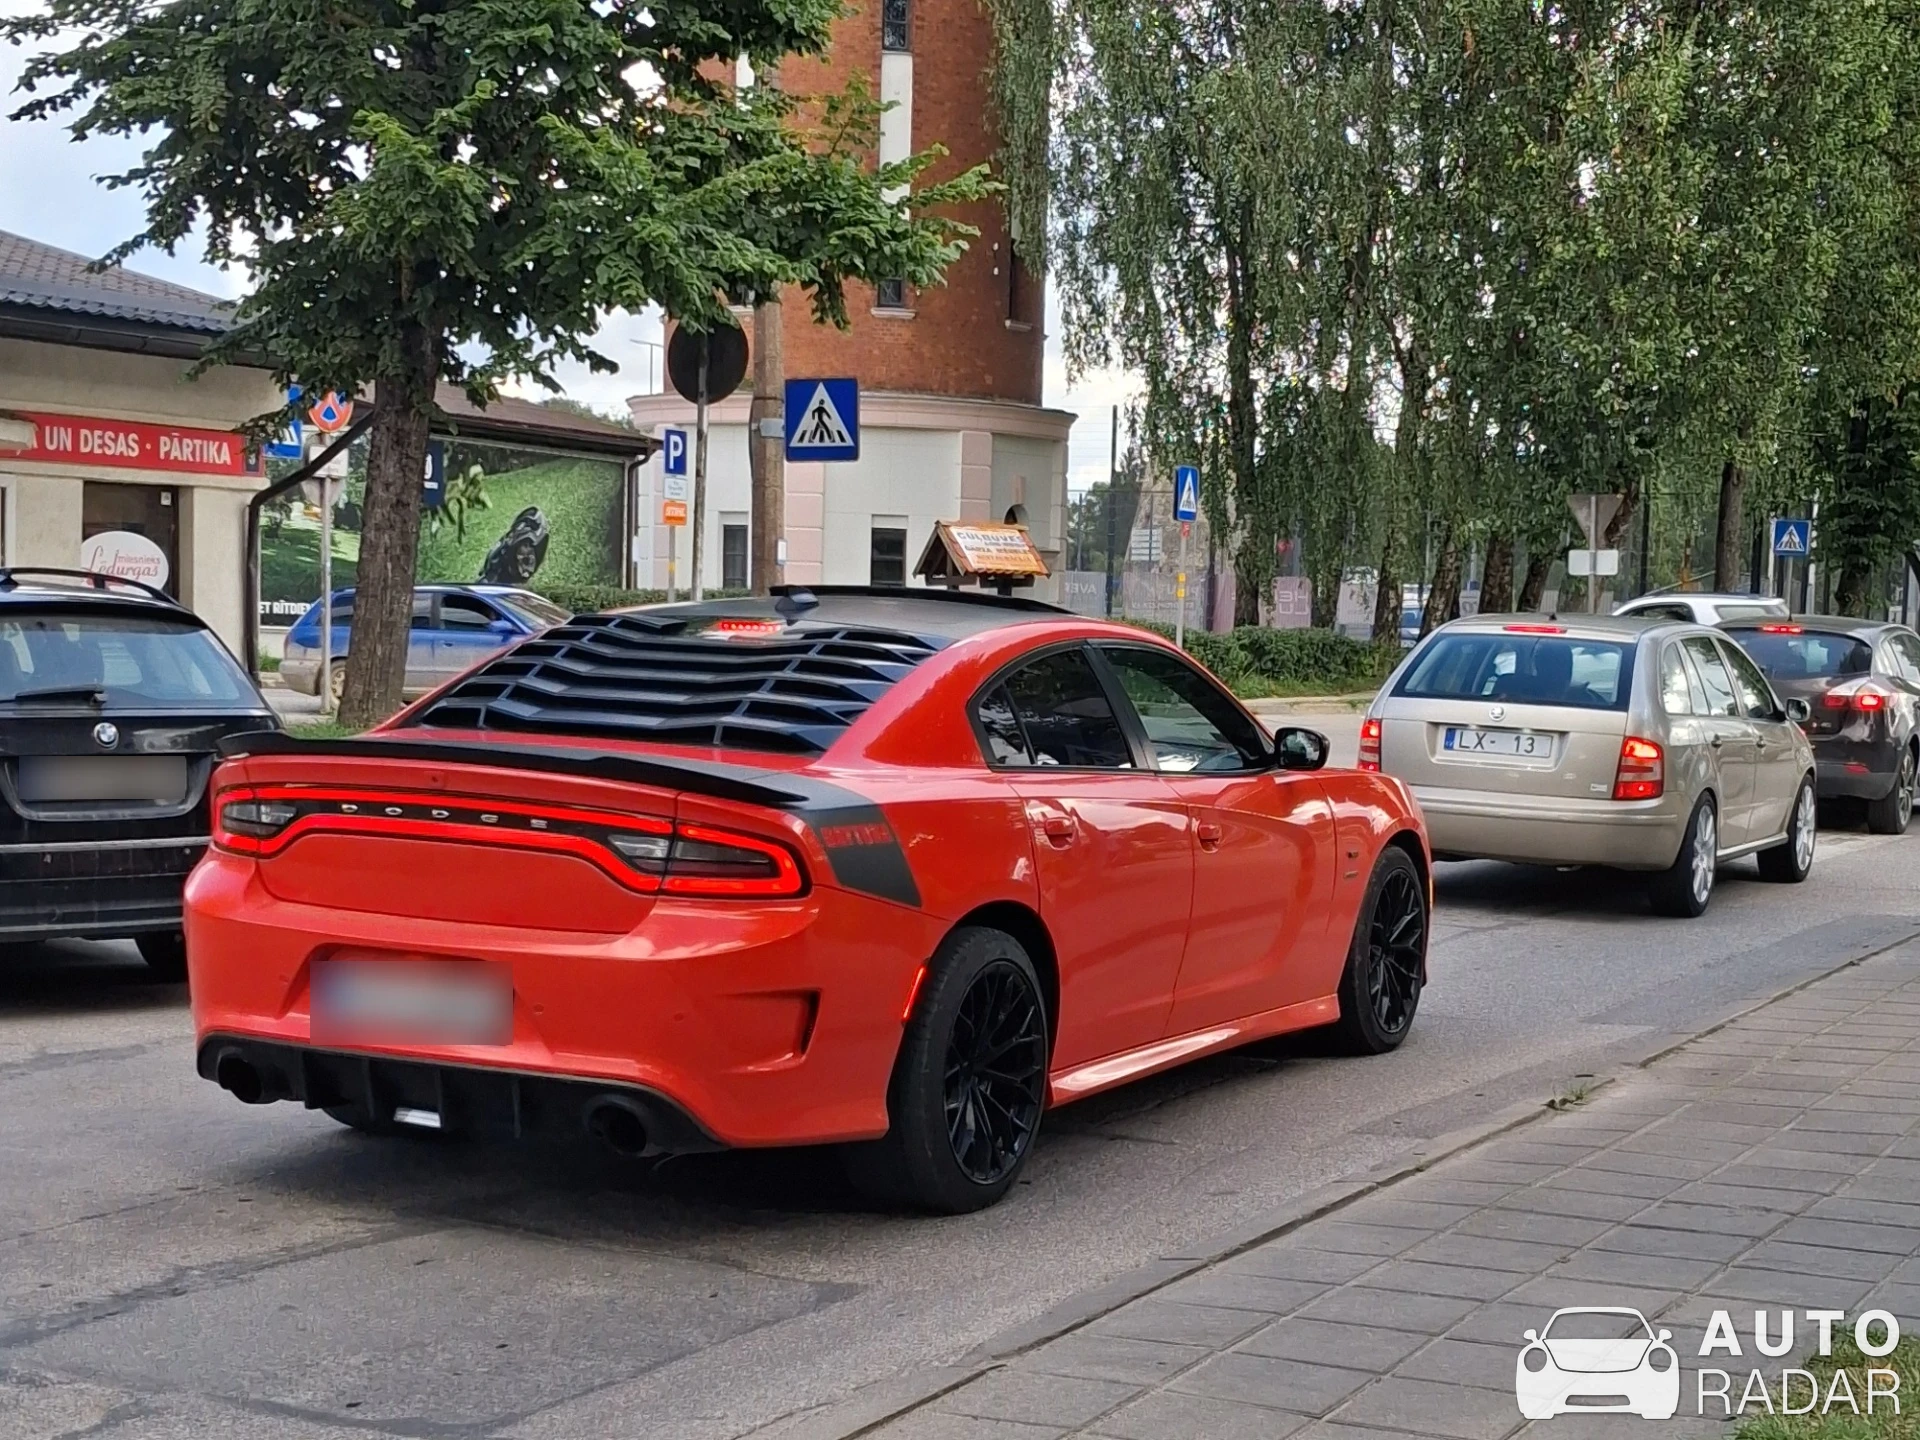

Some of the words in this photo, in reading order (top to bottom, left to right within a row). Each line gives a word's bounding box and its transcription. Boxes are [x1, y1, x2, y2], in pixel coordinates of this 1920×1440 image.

[45, 426, 72, 452] UN
[80, 429, 139, 458] DESAS
[160, 432, 232, 466] PĀRTIKA
[669, 434, 683, 470] P
[1514, 735, 1535, 754] 13
[341, 803, 548, 829] DODGE
